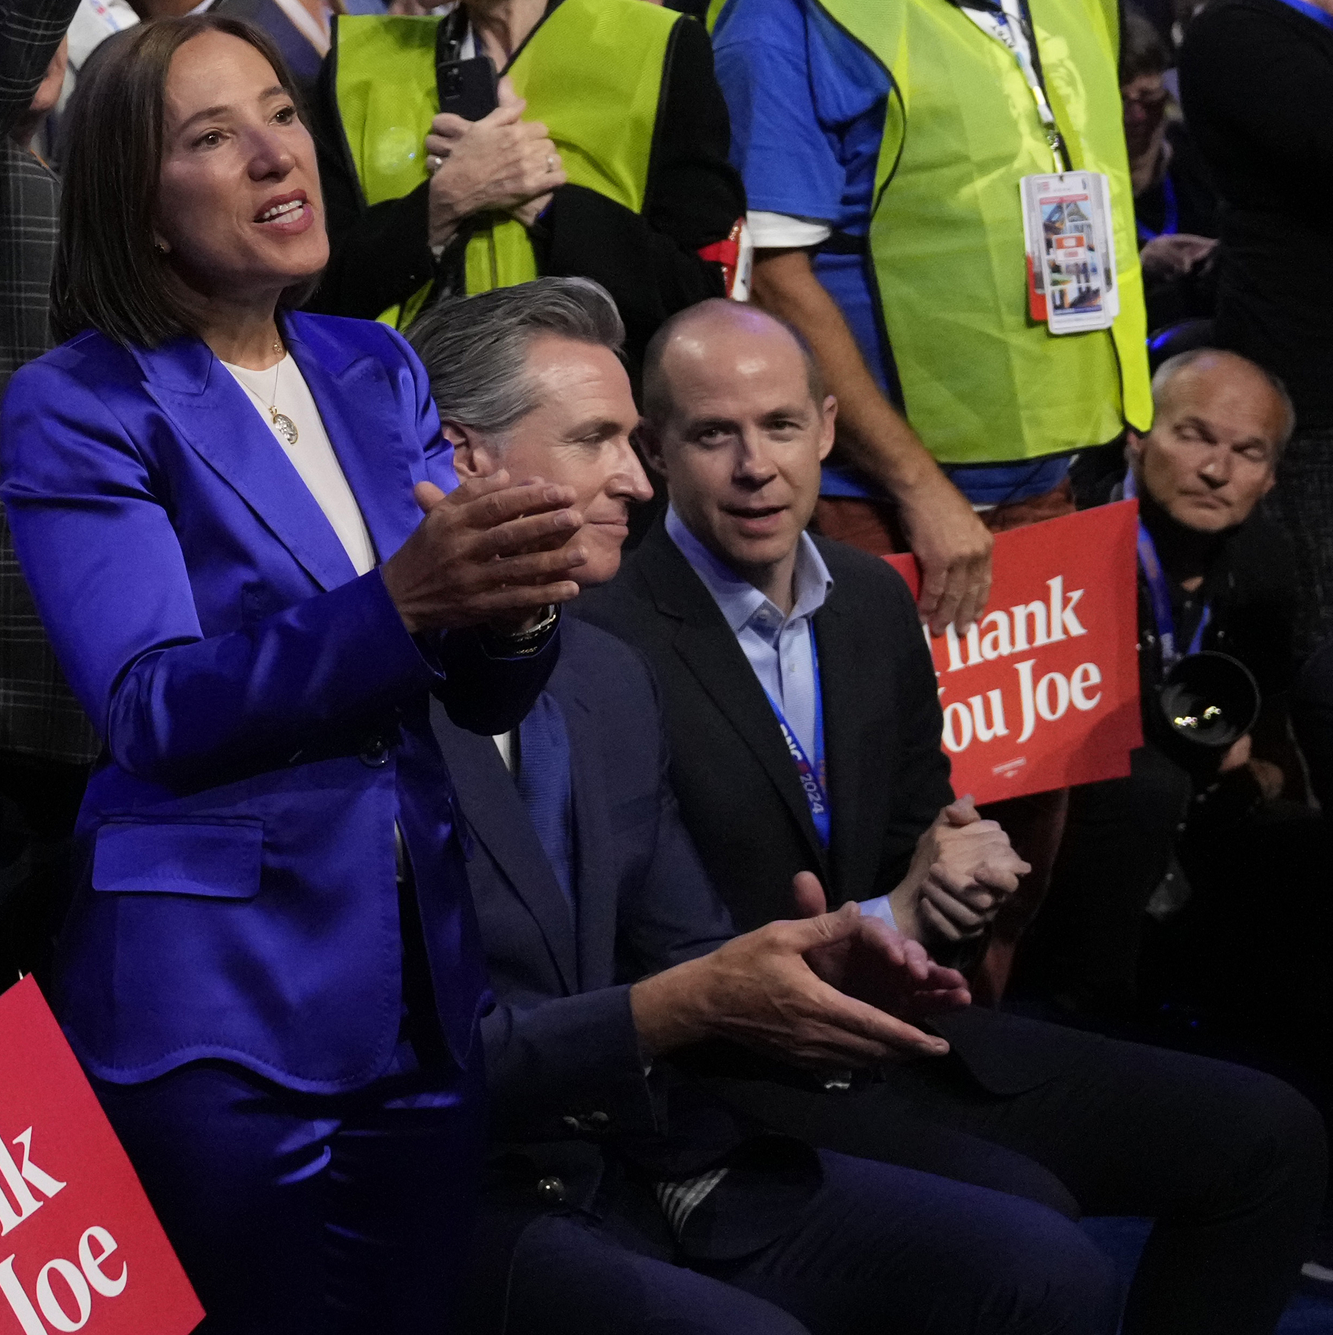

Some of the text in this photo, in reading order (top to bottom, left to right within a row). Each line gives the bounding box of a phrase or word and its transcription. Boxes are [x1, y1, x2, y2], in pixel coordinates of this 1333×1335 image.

[925, 575, 1088, 676] hank
[939, 659, 1103, 753] ou Joe
[799, 772, 825, 814] 2024
